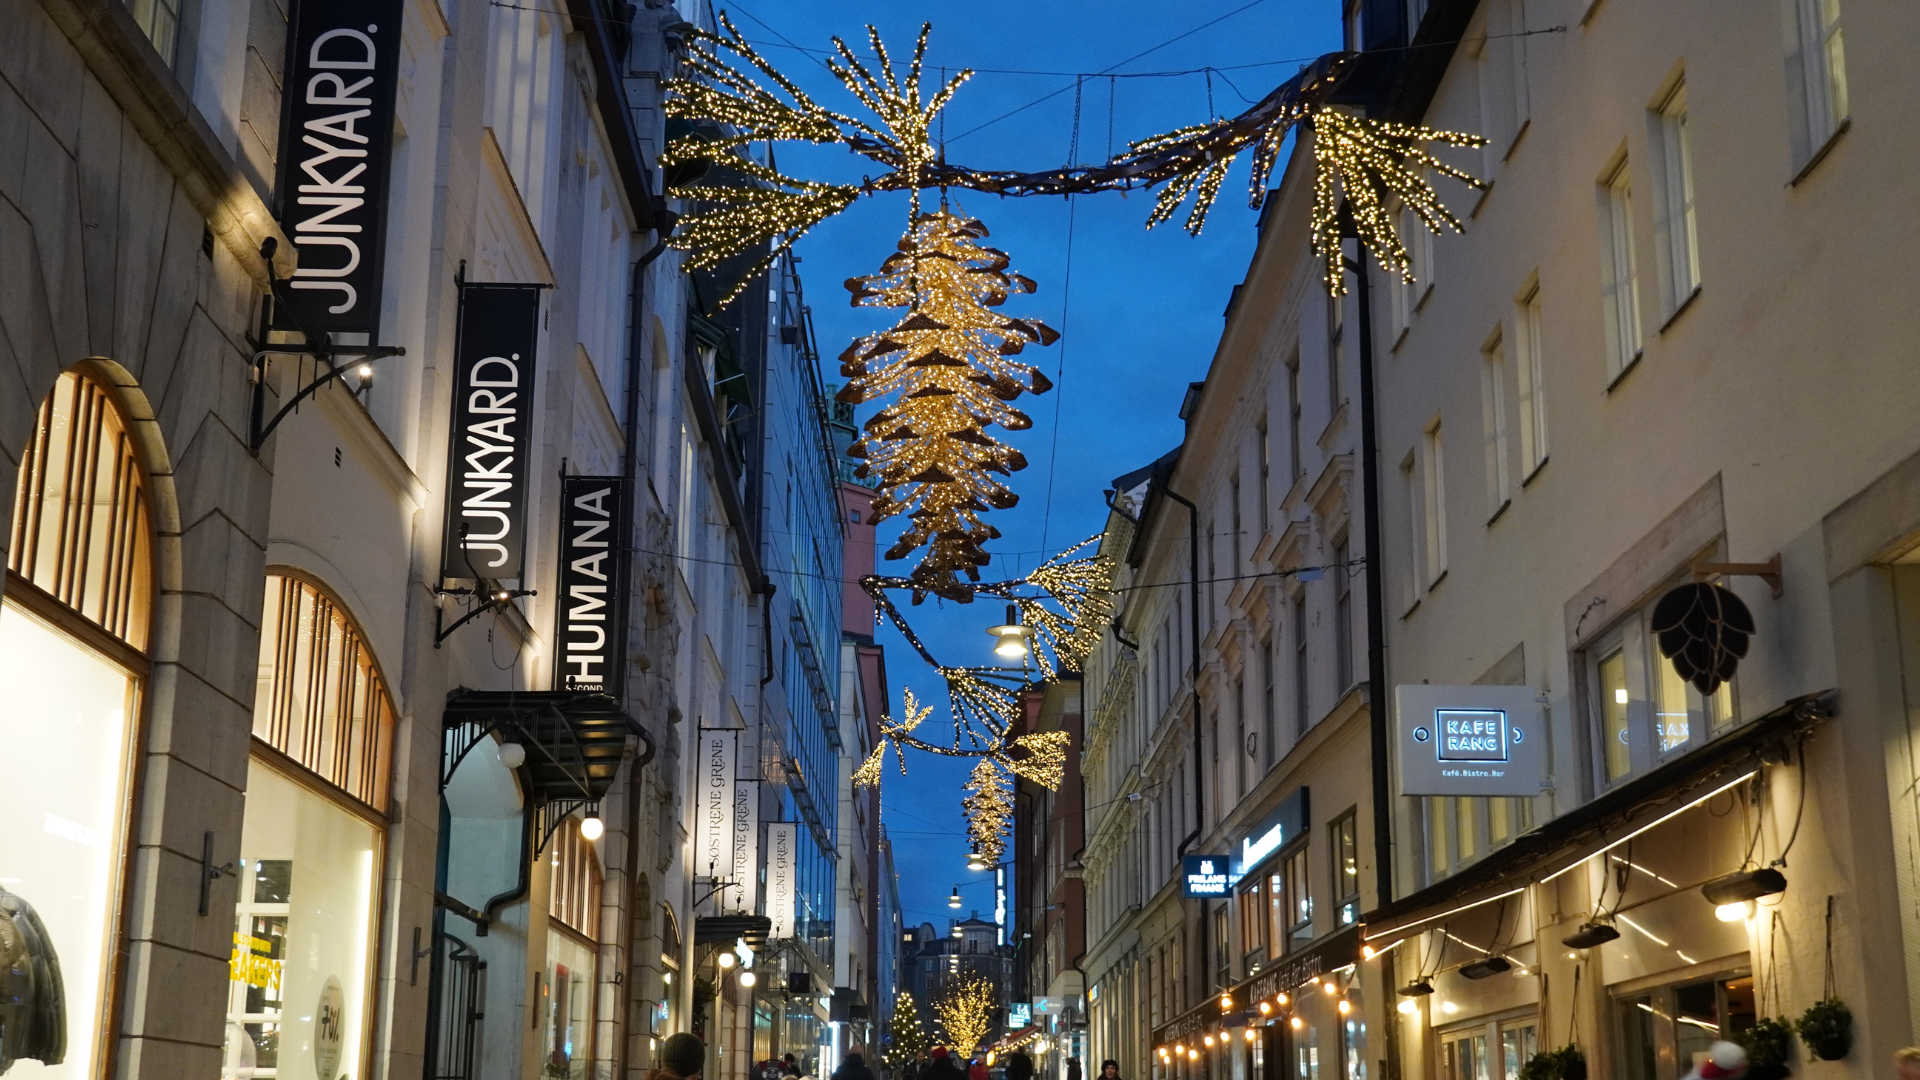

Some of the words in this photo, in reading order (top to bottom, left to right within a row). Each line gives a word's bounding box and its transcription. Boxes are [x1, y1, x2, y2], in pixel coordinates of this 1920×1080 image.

[290, 23, 378, 314] JUNKYARD.
[460, 353, 520, 567] JUNKYARD.
[565, 487, 611, 683] HUMANA
[1447, 720, 1496, 734] KAFE
[1448, 737, 1497, 751] RANG
[710, 738, 725, 788] GRENE
[708, 791, 724, 867] SØSTRENE
[737, 788, 750, 831] GRENE
[735, 834, 748, 901] SØSTRENE
[776, 830, 788, 869] GRENE
[775, 871, 787, 930] SØSTRENE
[1188, 874, 1226, 883] FRILANS
[1190, 884, 1225, 893] FINANS
[229, 948, 281, 991] EAKERS
